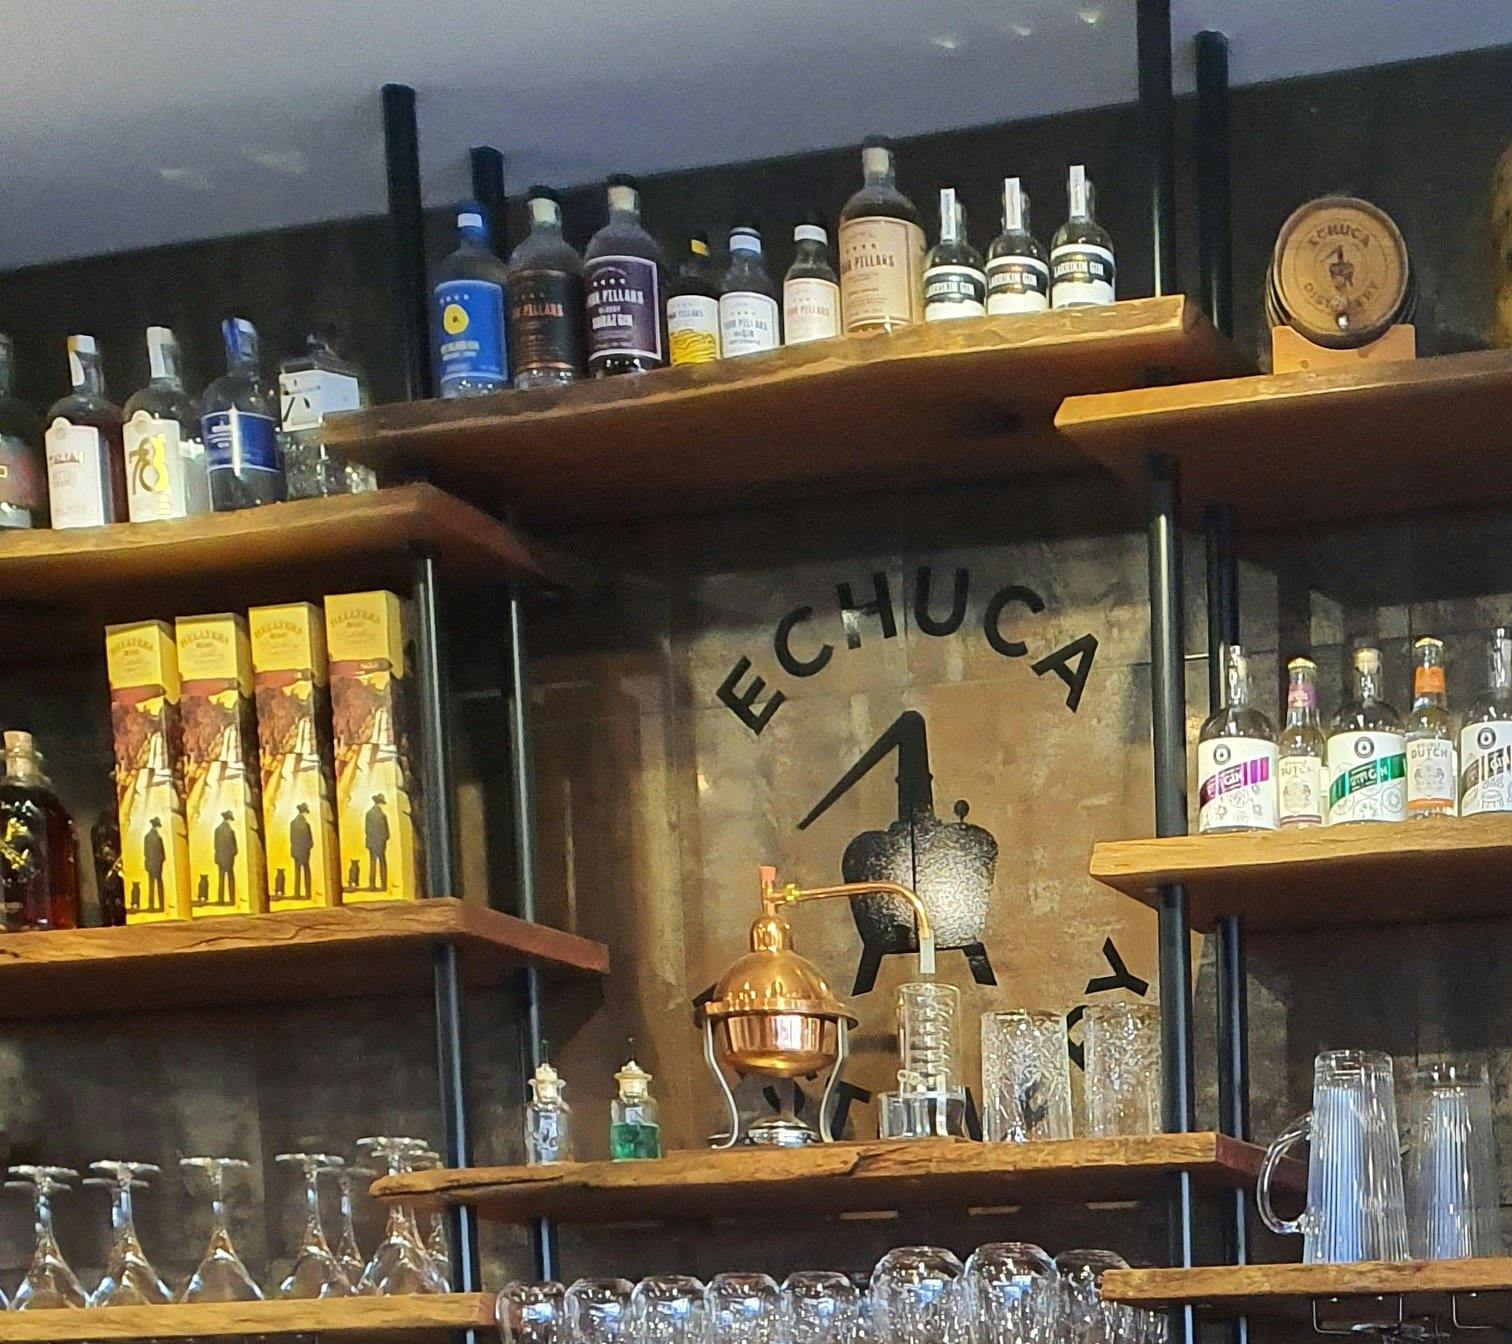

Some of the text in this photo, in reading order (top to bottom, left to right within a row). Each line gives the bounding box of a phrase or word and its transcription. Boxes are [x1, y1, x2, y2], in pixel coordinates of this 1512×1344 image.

[1308, 223, 1371, 248] ECHUCA
[855, 254, 894, 269] PILLARS
[602, 288, 644, 304] PILLARS
[716, 565, 1099, 735] ECHUCA
[1411, 748, 1449, 759] DUTCH
[1368, 765, 1388, 781] GN
